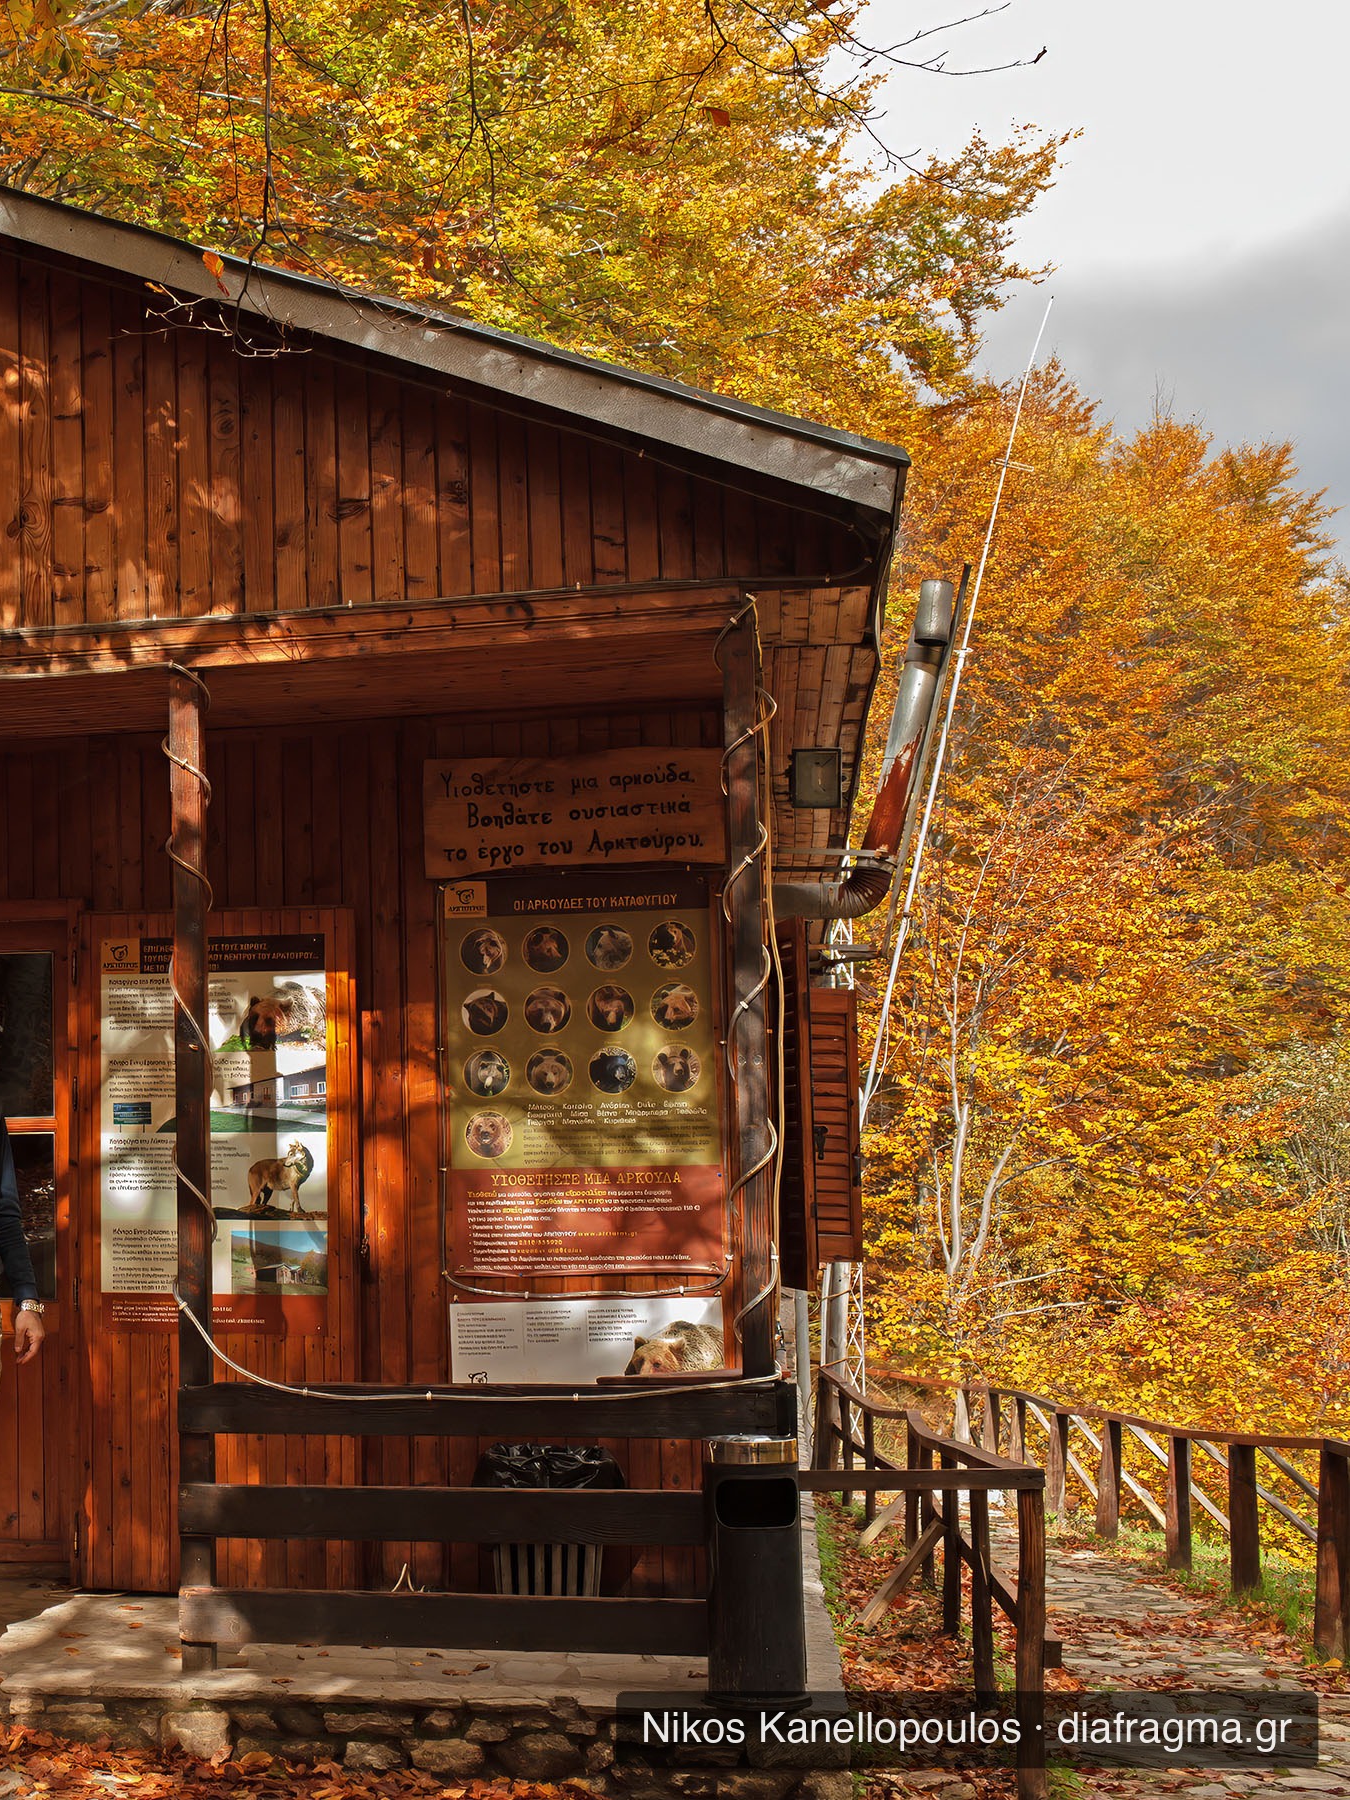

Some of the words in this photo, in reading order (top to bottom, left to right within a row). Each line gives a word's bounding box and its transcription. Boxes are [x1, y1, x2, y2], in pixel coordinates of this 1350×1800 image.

[570, 777, 599, 795] μια
[609, 762, 696, 793] αρκούδα.
[467, 802, 553, 829] Βοηθάτε
[569, 793, 691, 821] ουσιαστικά
[443, 848, 468, 862] το
[478, 838, 525, 867] έργο
[538, 840, 573, 856] του
[587, 828, 704, 858] Αρκτούρου.
[513, 899, 525, 911] ΟΙ
[527, 897, 584, 911] ΑΡΚΟΥΔΕΣ
[586, 896, 607, 909] ΤΟΥ
[491, 1173, 581, 1186] ΥΙΟΘΕΤΗΣΤΕ
[584, 1172, 612, 1185] ΜΙΑ
[617, 1171, 682, 1185] ΑΡΚΟΥΔΑ
